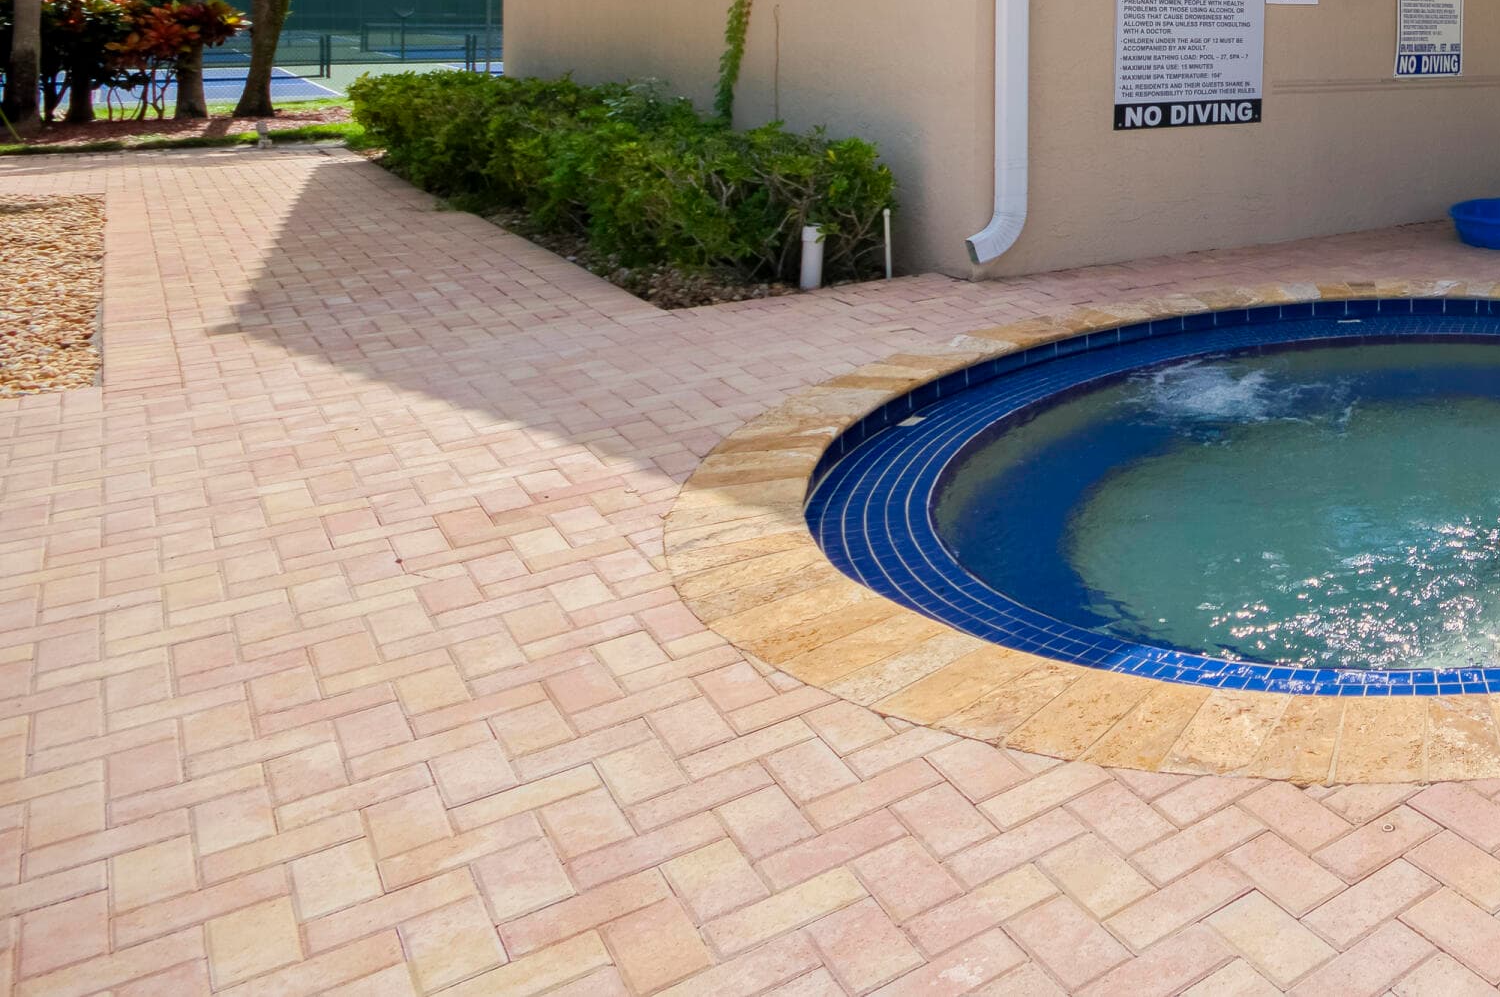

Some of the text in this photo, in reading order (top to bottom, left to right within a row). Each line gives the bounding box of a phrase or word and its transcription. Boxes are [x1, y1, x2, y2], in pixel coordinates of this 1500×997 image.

[1399, 55, 1458, 73] NO DIVING
[1125, 102, 1252, 127] NO DIVING
